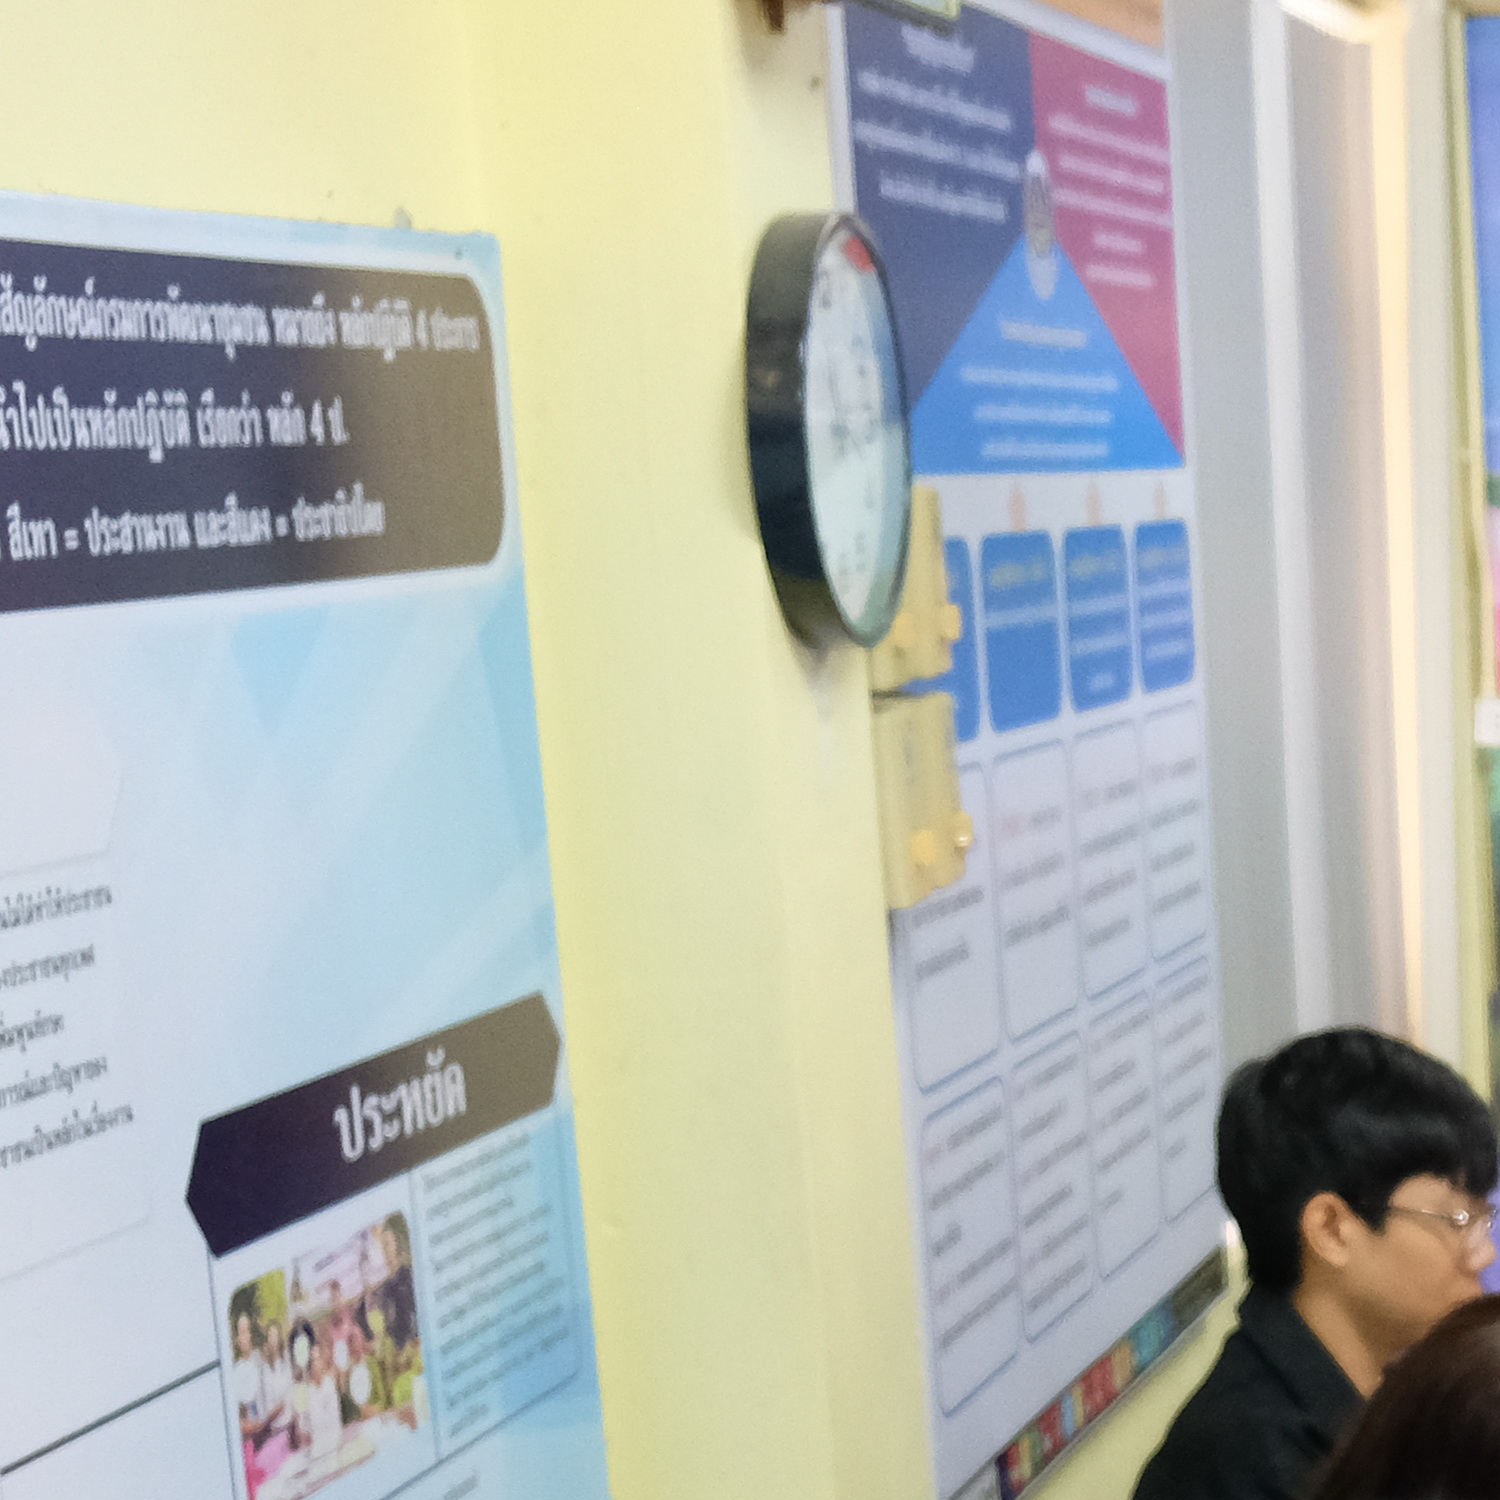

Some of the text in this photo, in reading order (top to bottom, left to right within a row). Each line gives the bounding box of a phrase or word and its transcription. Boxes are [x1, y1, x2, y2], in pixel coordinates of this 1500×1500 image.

[309, 398, 326, 447] 4
[7, 500, 58, 561] สีเทา
[84, 506, 191, 556] ประสานงาน
[332, 1047, 468, 1163] ประหยัด
